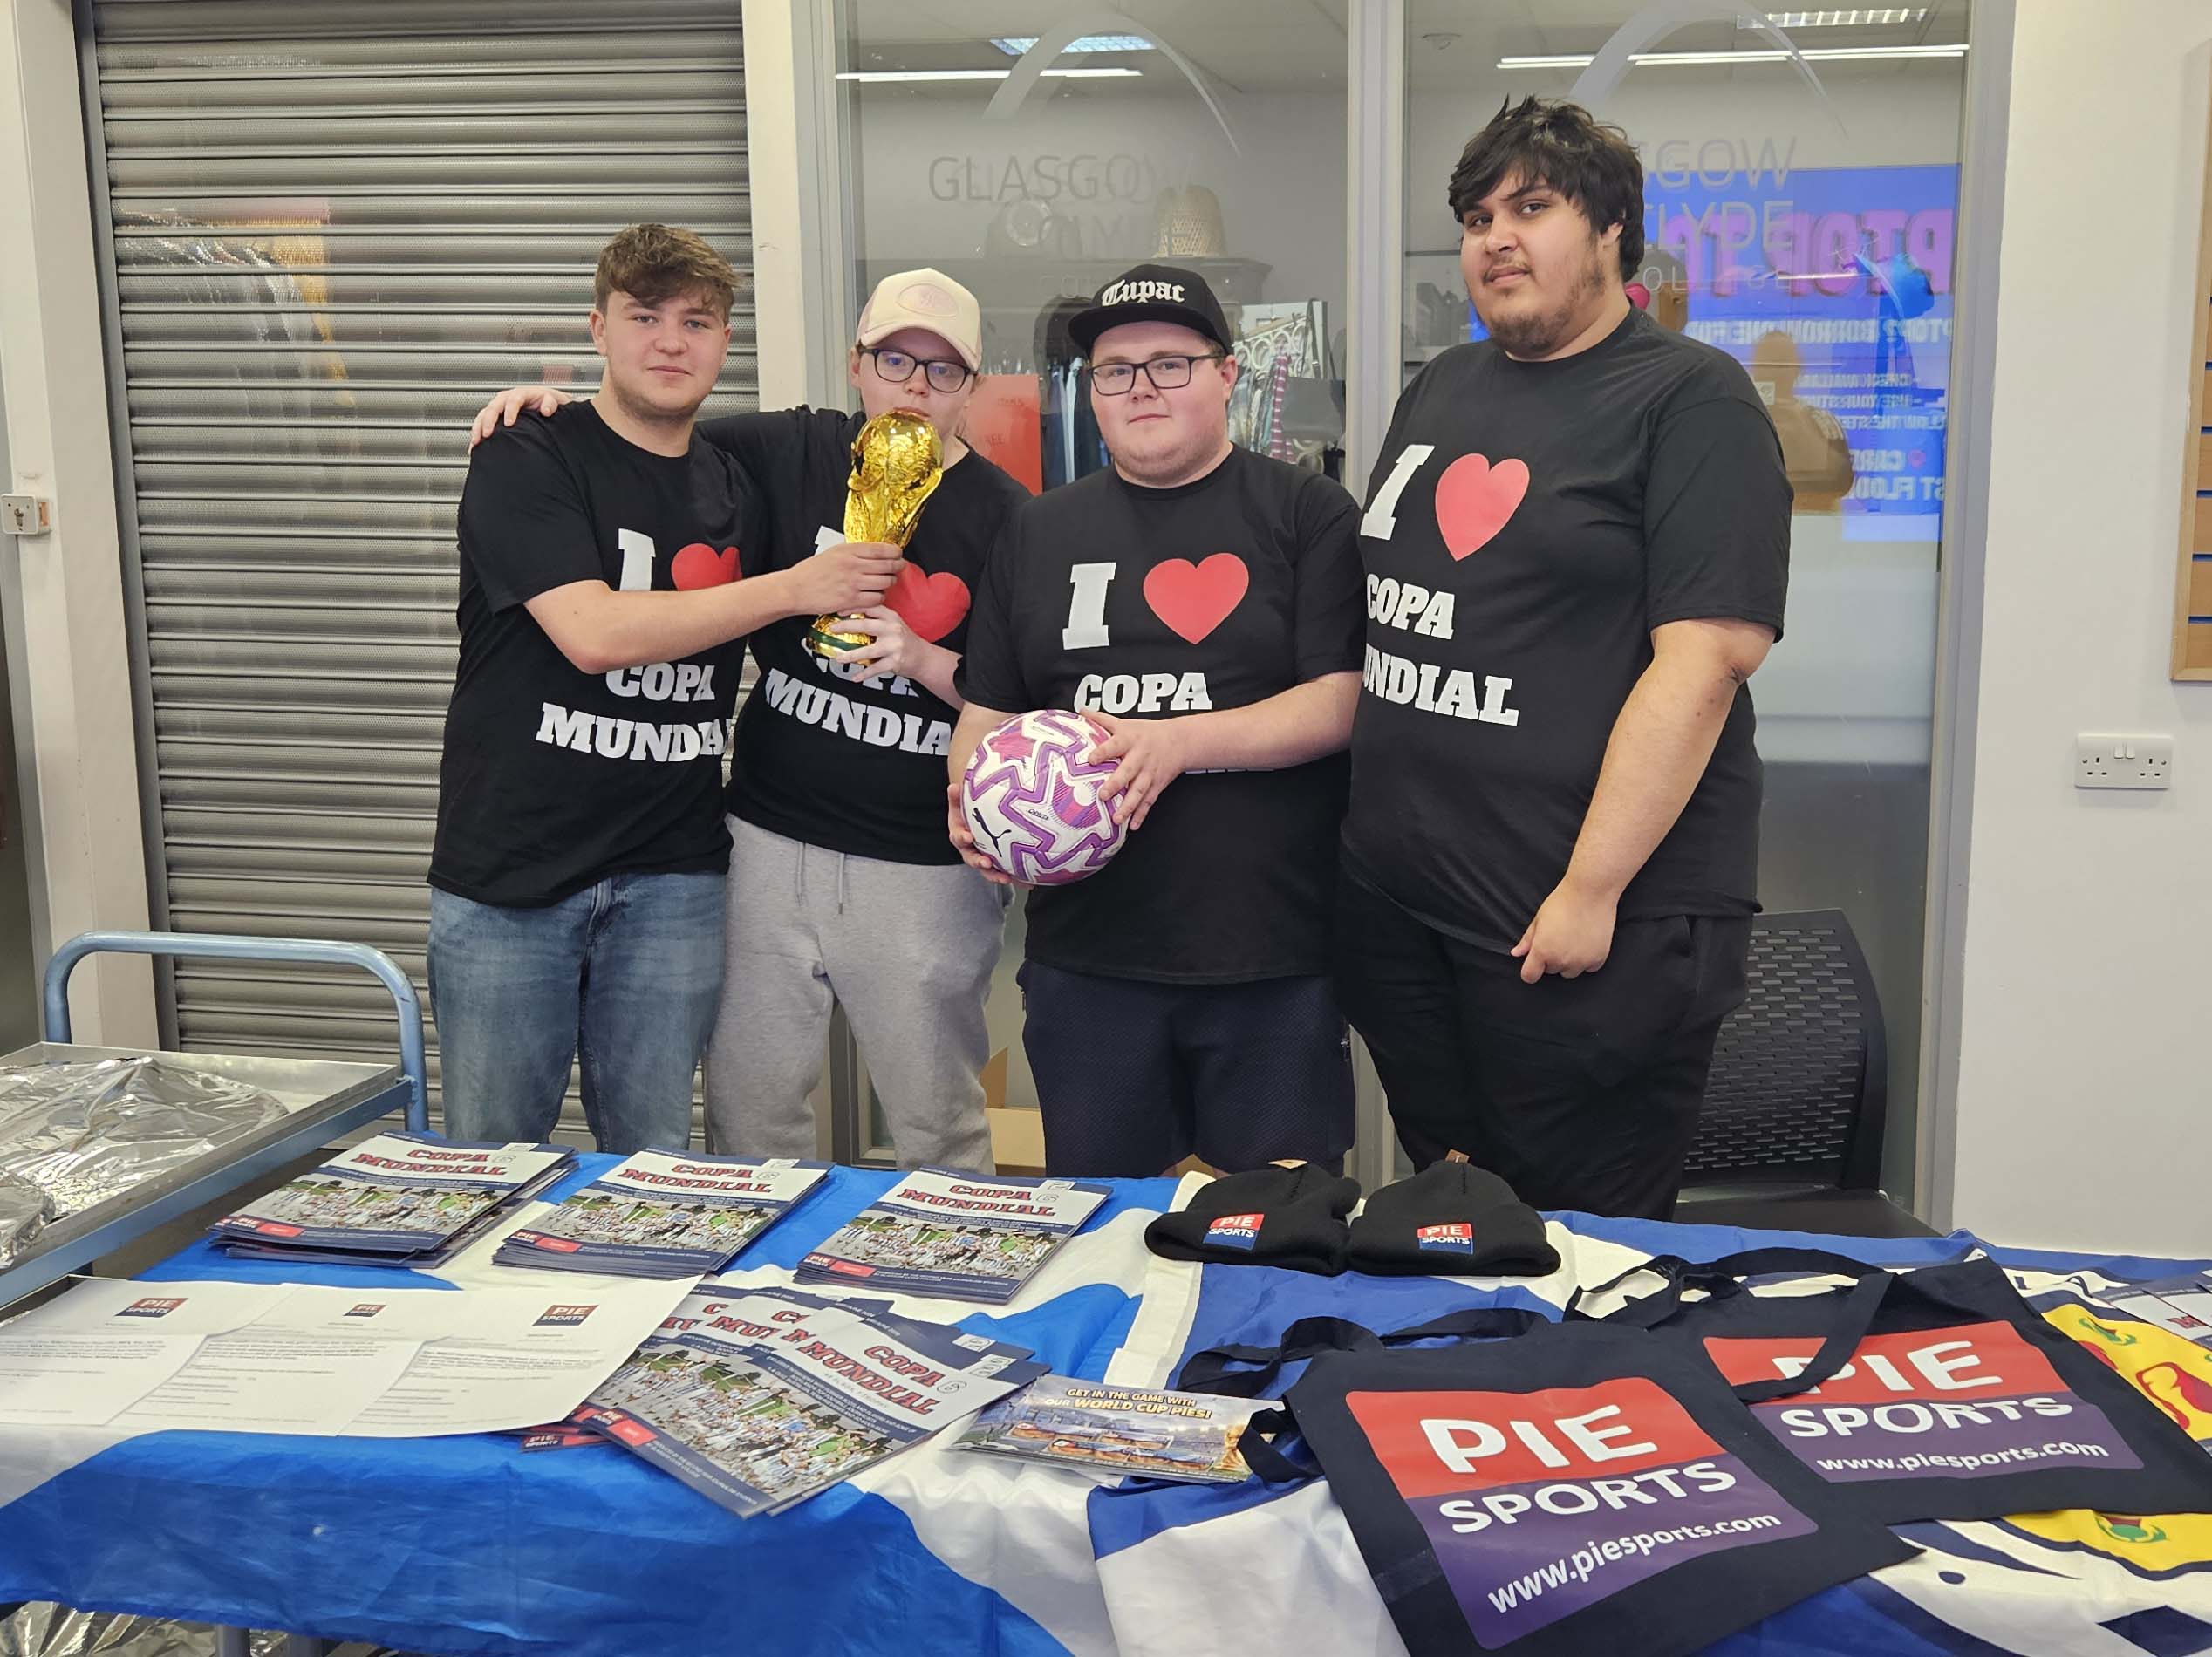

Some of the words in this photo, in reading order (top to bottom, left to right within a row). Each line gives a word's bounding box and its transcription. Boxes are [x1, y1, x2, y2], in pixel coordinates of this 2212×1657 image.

[927, 154, 1191, 203] GLASGO
[1101, 278, 1185, 306] Tupac
[1359, 444, 1436, 541] I
[1062, 562, 1116, 651] I
[1366, 573, 1456, 640] COPA
[605, 662, 717, 703] COPA
[1073, 672, 1212, 714] COPA
[764, 667, 952, 757] MUNDIA
[535, 701, 734, 763] MUNDIA
[351, 1152, 508, 1176] MUNDIAL
[407, 1148, 490, 1164] COPA
[671, 1163, 754, 1179] COPA
[617, 1167, 775, 1194] MUNDIAL
[948, 1183, 1033, 1202] COPA
[897, 1187, 1056, 1217] MUNDIAL
[1207, 1227, 1256, 1238] SPORTS
[1219, 1216, 1256, 1228] PIE
[1425, 1224, 1464, 1236] PIE
[1421, 1236, 1471, 1246] SPORTS
[550, 1306, 590, 1315] PIE
[797, 1340, 942, 1416] MUNDIAL
[864, 1344, 948, 1389] COPA
[1771, 1340, 2004, 1395] PIE
[1045, 1398, 1070, 1407] OUR
[1073, 1398, 1134, 1412] WORLD
[1135, 1402, 1170, 1415] CUP
[1170, 1405, 1213, 1420] PIES!
[1066, 1388, 1090, 1398] GET
[1090, 1389, 1105, 1399] IN
[1108, 1390, 1130, 1401] THE
[1131, 1393, 1166, 1404] GAME
[1166, 1395, 1198, 1408] WITH
[1779, 1397, 2074, 1439] SPORTS
[1419, 1403, 1659, 1474] PIE
[1817, 1439, 2109, 1473] www.piesports.com
[1438, 1460, 1738, 1534] SPORTS
[1487, 1511, 1782, 1613] www.piesports.com
